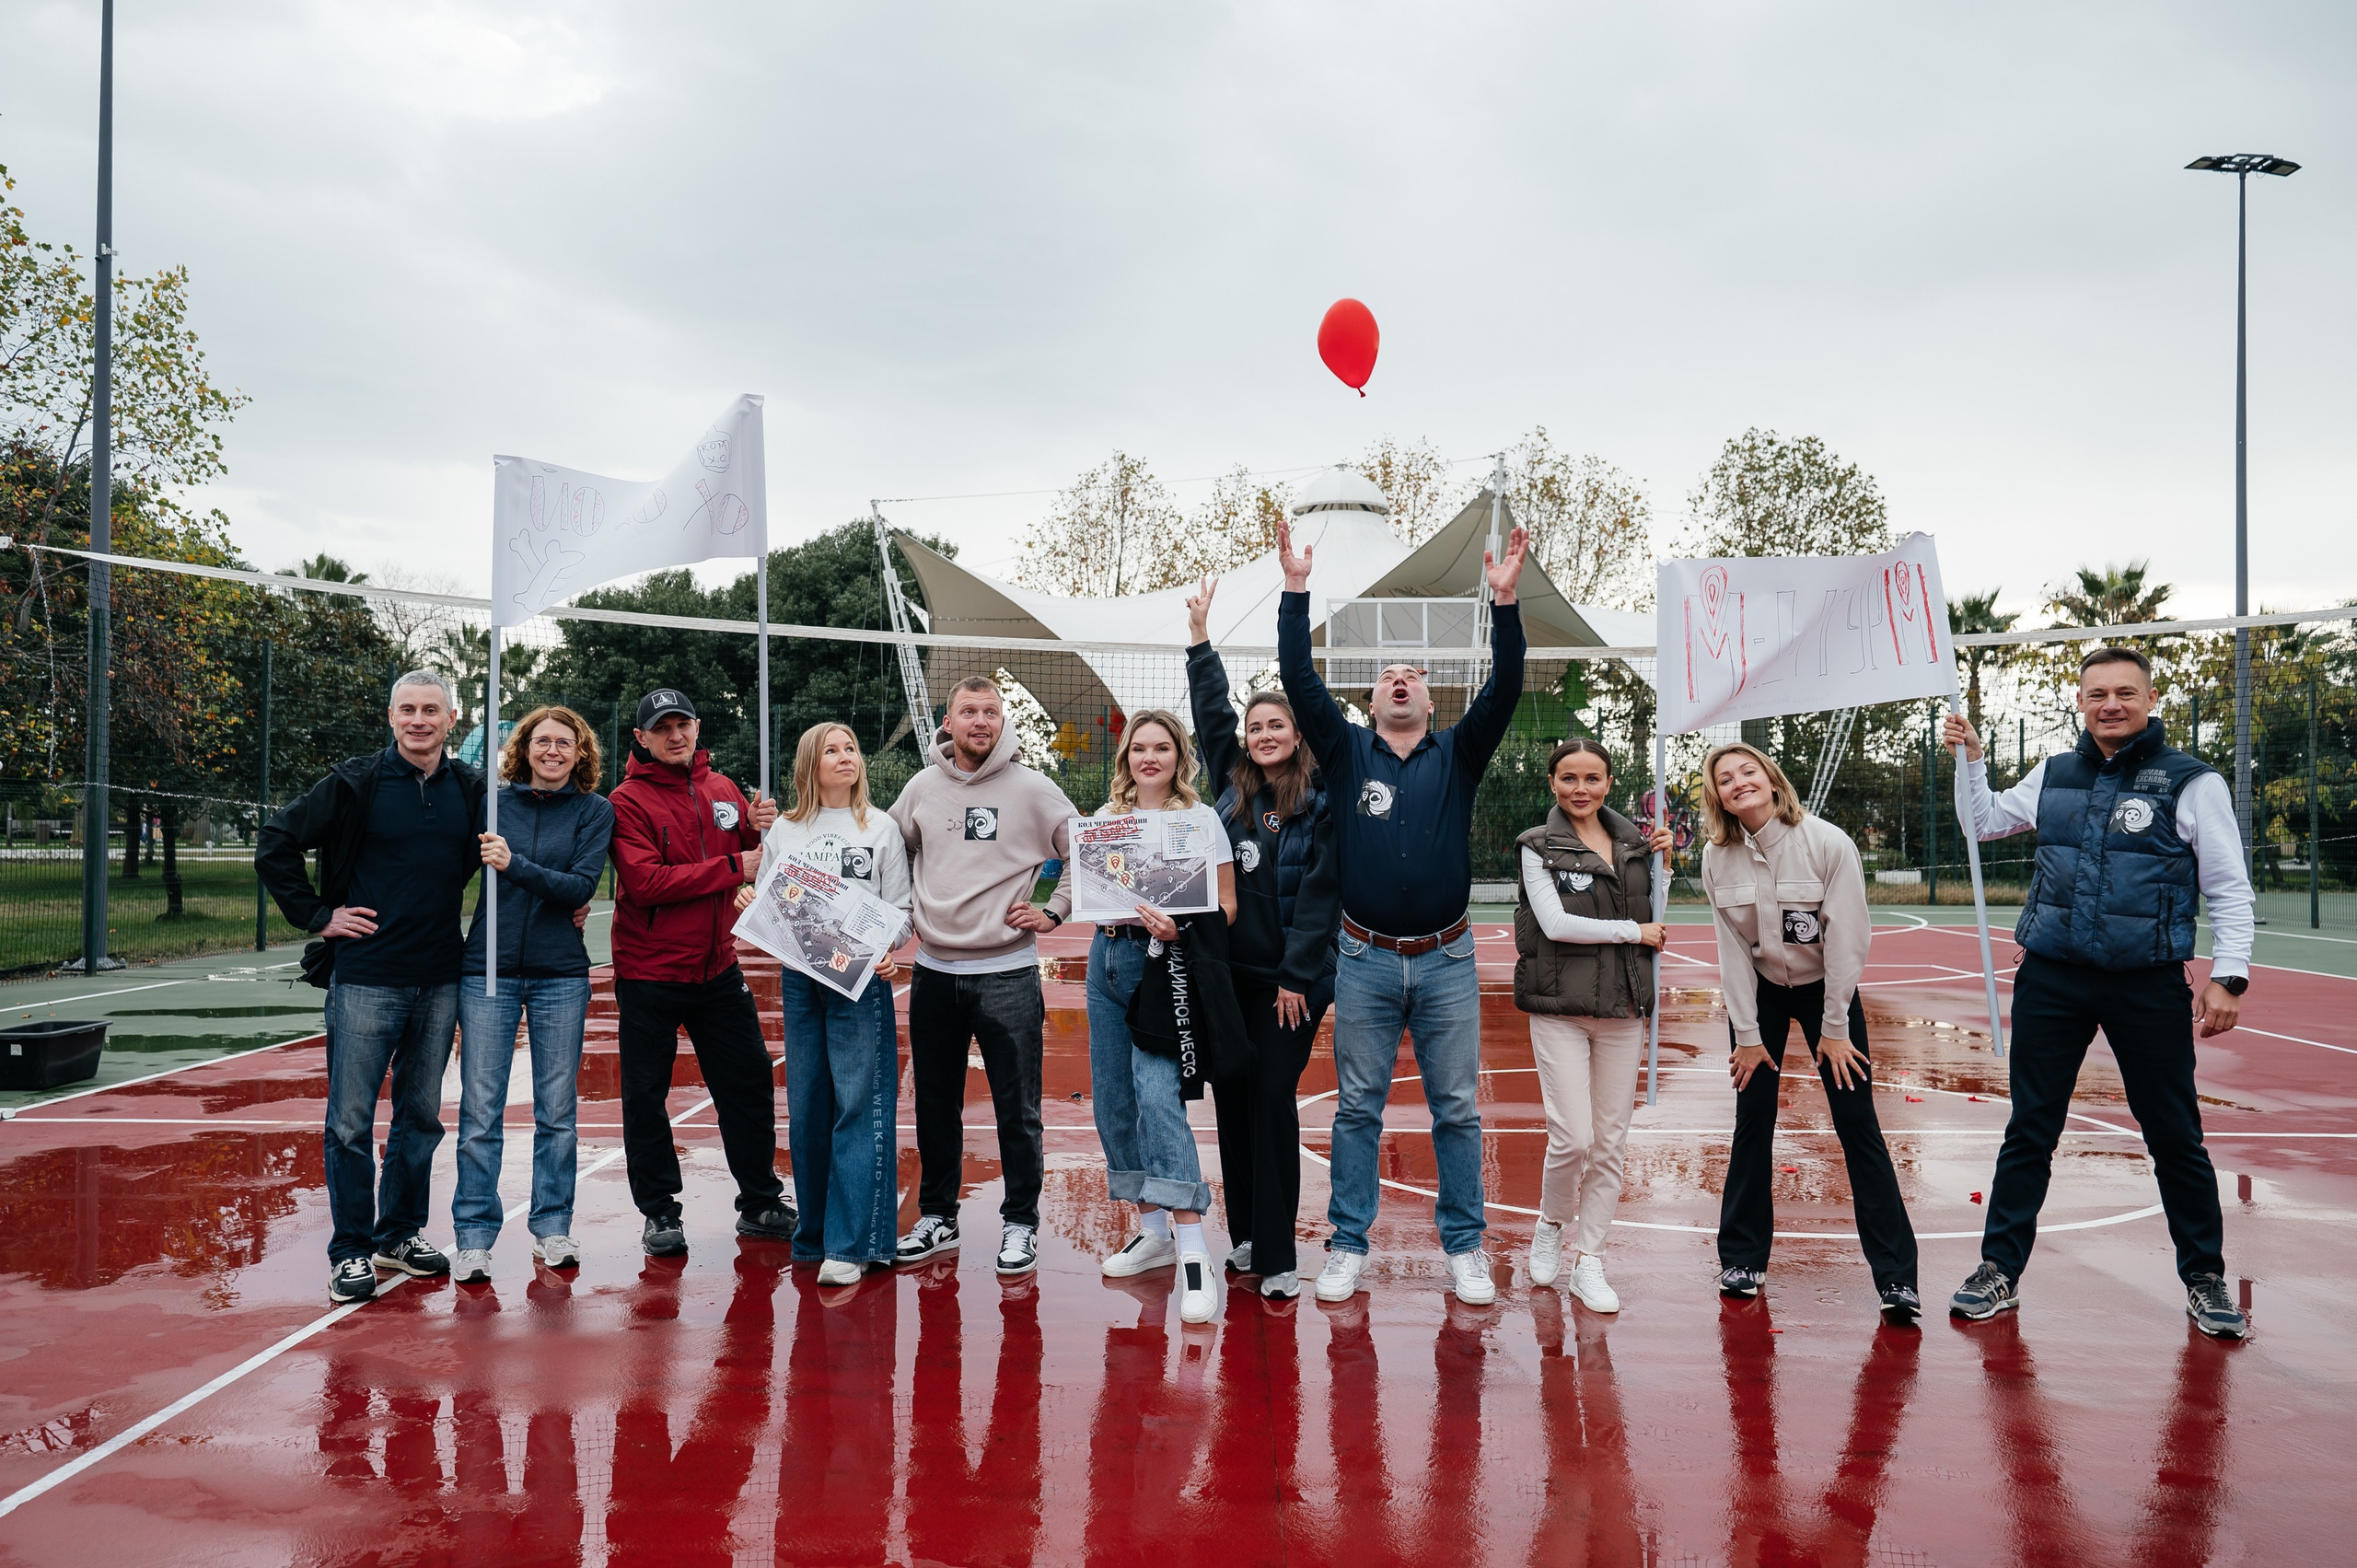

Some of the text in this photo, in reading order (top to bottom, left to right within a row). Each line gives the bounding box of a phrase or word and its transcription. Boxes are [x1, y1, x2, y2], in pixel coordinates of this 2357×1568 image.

[2138, 768, 2167, 777] ARMANI
[2134, 775, 2173, 786] EXCHANGE
[805, 835, 822, 848] GOOD
[872, 1093, 883, 1181] WEEKEND
